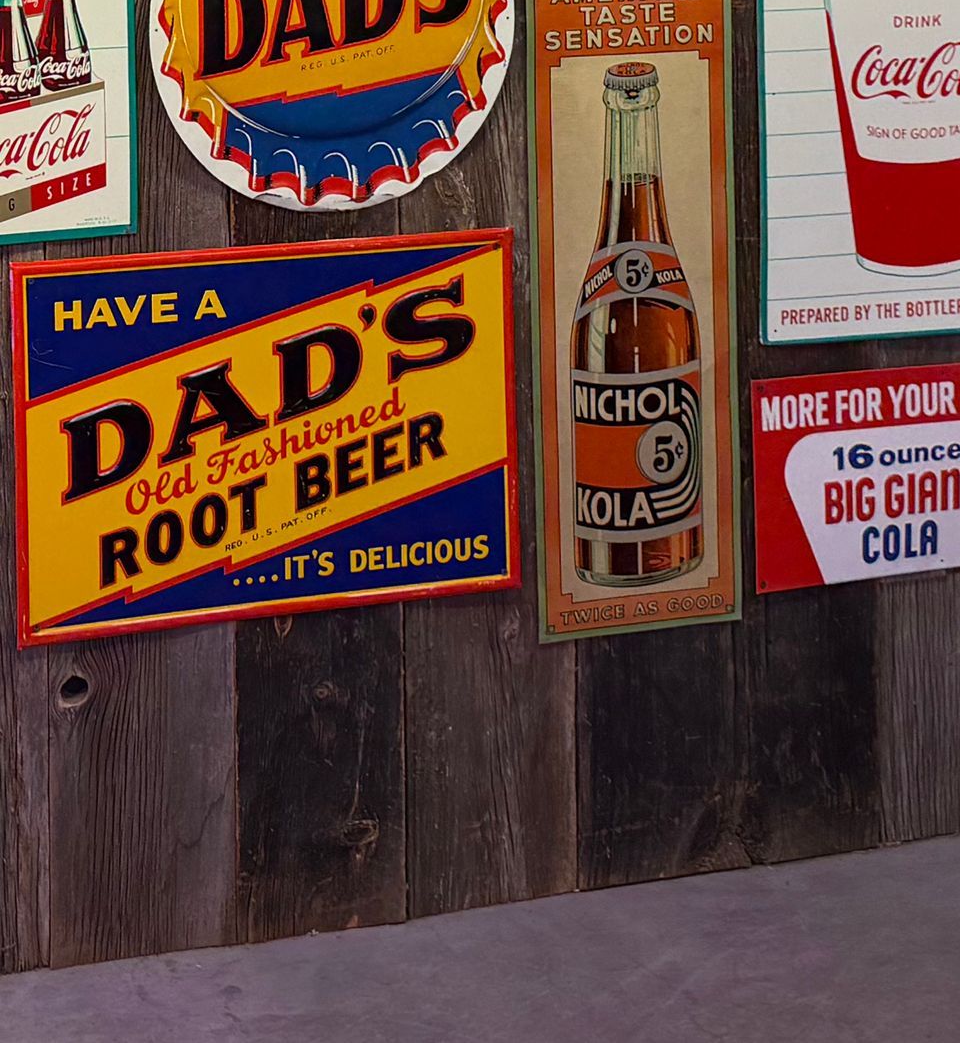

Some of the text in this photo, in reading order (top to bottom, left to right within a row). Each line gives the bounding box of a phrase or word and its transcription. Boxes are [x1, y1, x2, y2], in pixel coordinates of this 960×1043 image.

[580, 3, 676, 26] TASTE
[893, 14, 942, 28] DRINK
[545, 23, 715, 51] SENSATION
[39, 52, 91, 80] Coca-Cola
[866, 125, 890, 138] SIGN
[892, 128, 907, 139] OF
[910, 126, 946, 139] GOOD
[46, 172, 92, 200] SIZE
[584, 259, 683, 298] NICHOL 5¢ KOLA
[54, 289, 227, 332] HAVE A
[781, 307, 849, 325] PREPARED
[854, 304, 872, 321] BY
[877, 303, 901, 319] THE
[61, 274, 477, 506] DAD'S
[575, 385, 681, 422] NICHOL
[760, 391, 830, 432] MORE
[835, 387, 883, 424] FOR
[887, 380, 957, 420] YOUR
[125, 387, 408, 516] Old Fashioned
[652, 435, 684, 473] 5¢
[833, 443, 875, 471] 16
[99, 410, 448, 591] ROOT BEER
[576, 488, 655, 527] KOLA
[824, 476, 876, 525] BIG
[350, 534, 490, 572] DELICIOUS
[862, 520, 939, 564] COLA
[560, 594, 724, 626] TWICE AS GOOD
